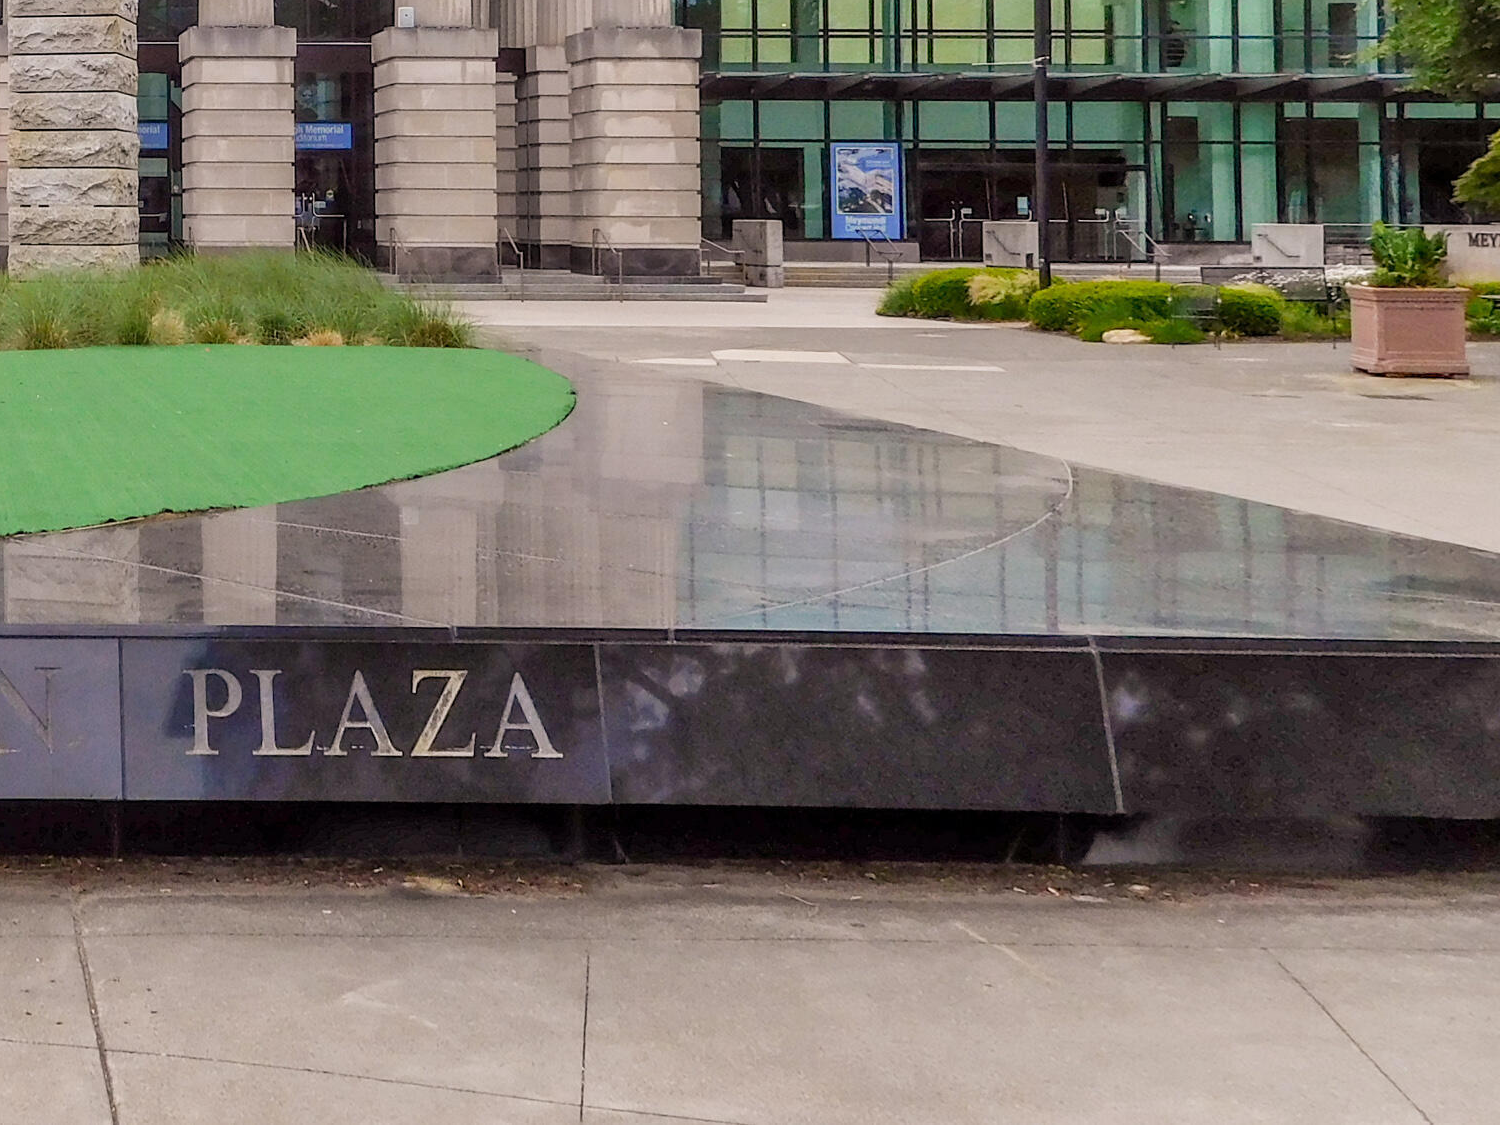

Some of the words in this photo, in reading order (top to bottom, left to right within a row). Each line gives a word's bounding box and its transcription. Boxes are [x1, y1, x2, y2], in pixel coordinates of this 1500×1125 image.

[305, 124, 344, 134] Memorial
[1468, 233, 1500, 247] MEY
[182, 669, 565, 759] PLAZA
